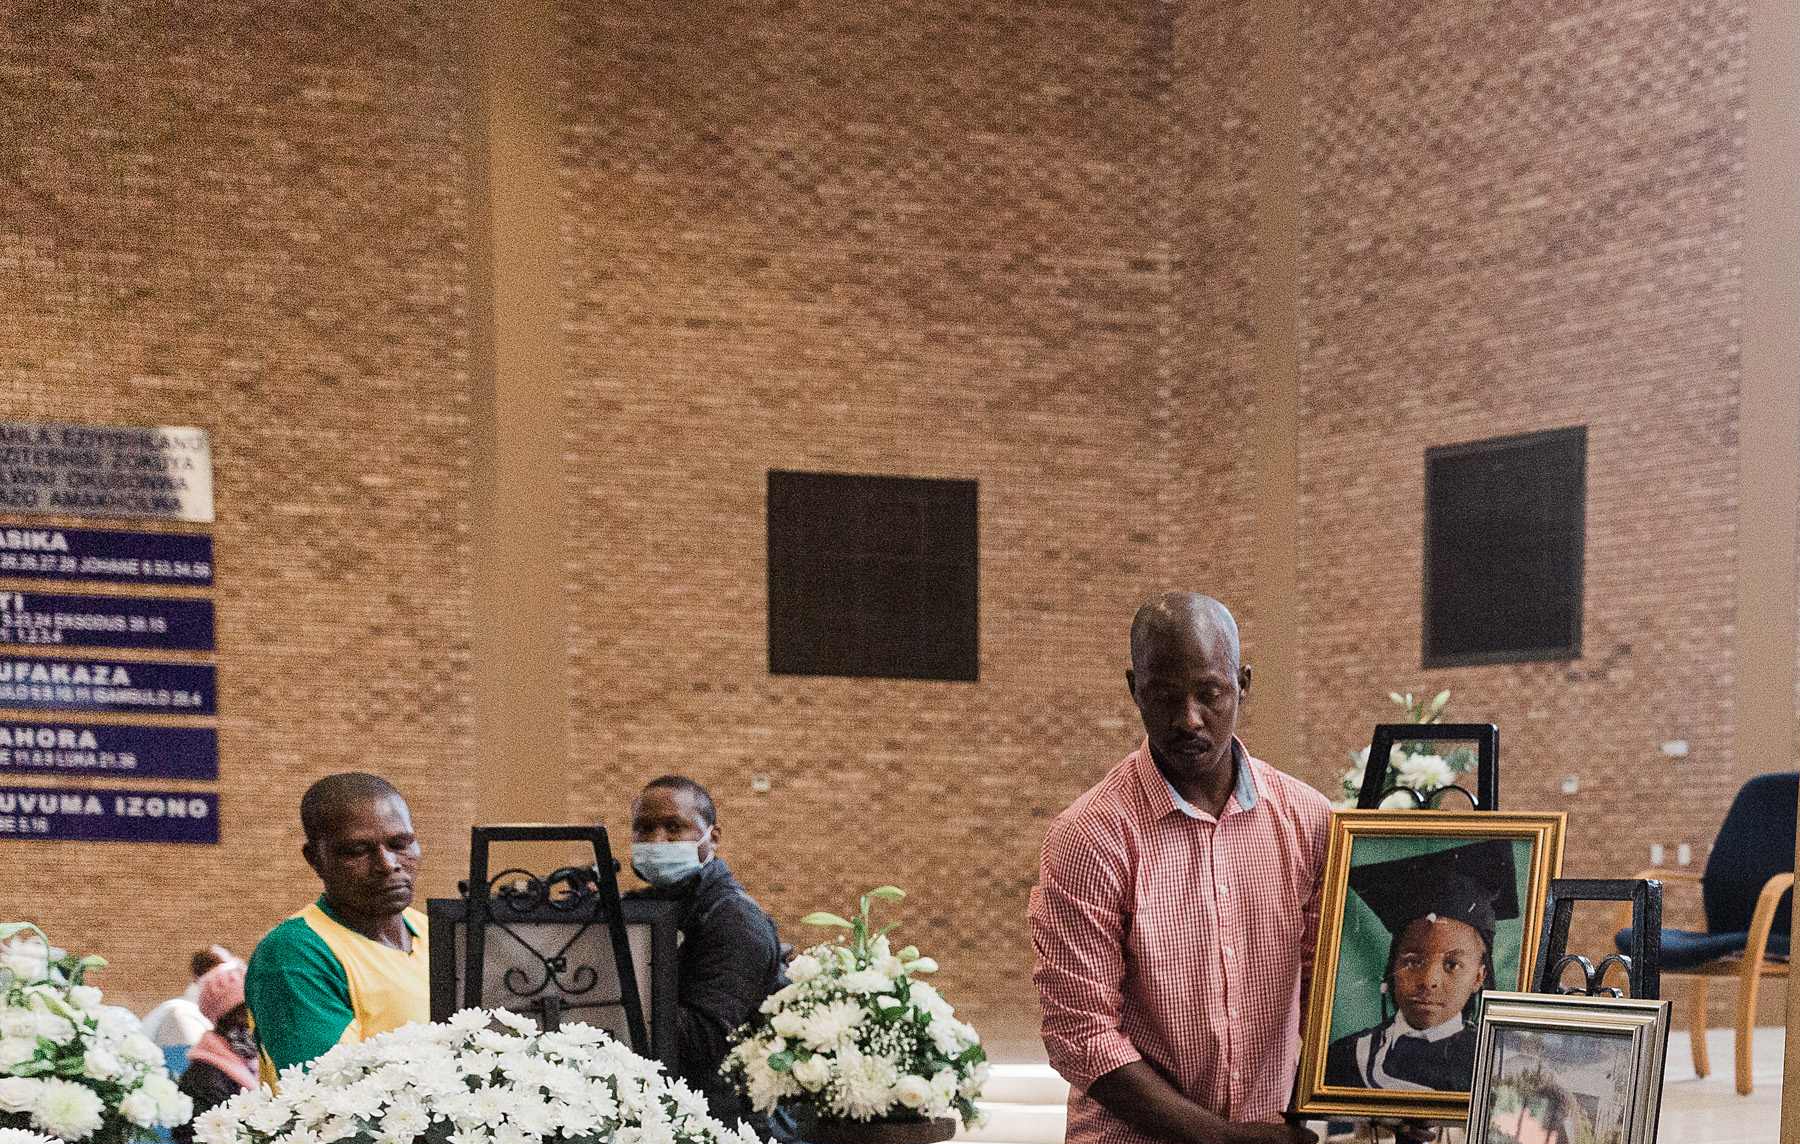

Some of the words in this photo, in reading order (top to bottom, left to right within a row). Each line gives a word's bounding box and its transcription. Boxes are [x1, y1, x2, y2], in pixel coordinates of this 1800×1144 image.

[0, 727, 97, 748] AHORA
[0, 793, 104, 815] UVUMA
[114, 796, 209, 819] IZONO
